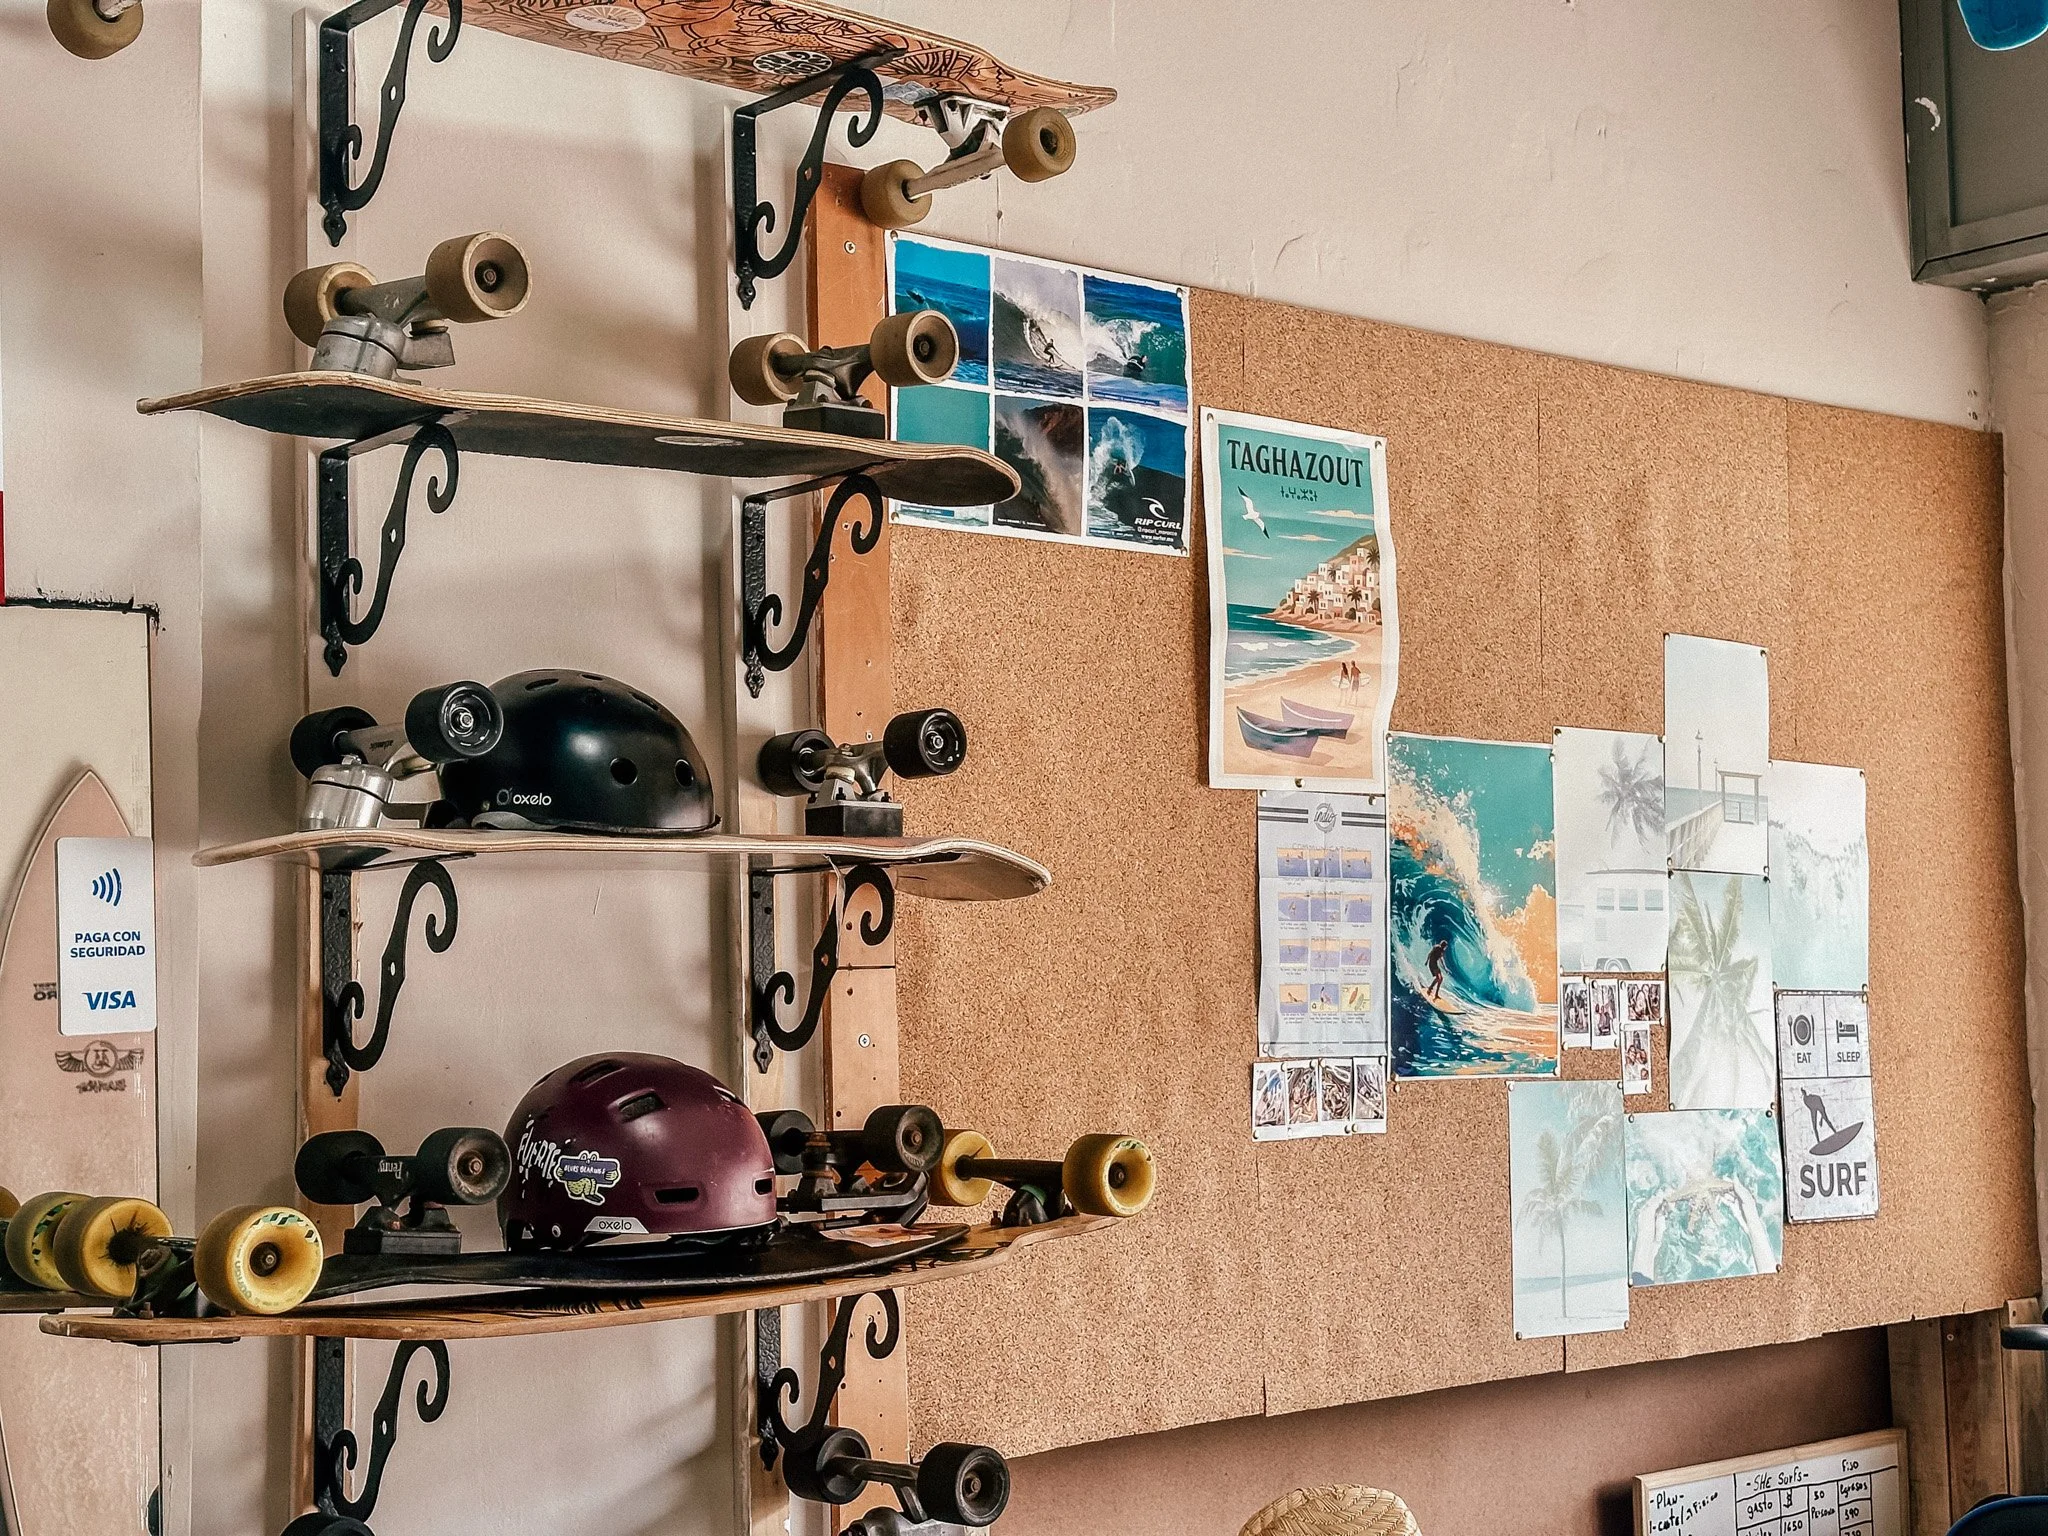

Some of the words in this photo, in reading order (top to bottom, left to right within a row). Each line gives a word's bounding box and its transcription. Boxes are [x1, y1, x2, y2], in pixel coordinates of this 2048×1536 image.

[1227, 439, 1363, 488] TAGHAZOUT
[1134, 517, 1153, 526] RIP
[1154, 520, 1182, 530] CURL
[512, 792, 552, 806] oxelo
[75, 932, 111, 943] PAGA
[113, 931, 141, 942] CON
[70, 945, 146, 958] SEGURIDAD
[82, 990, 137, 1010] VISA
[1796, 1052, 1812, 1064] EAT
[1837, 1051, 1861, 1062] SLEEP
[377, 1160, 403, 1179] Penny
[1800, 1162, 1867, 1199] SURF
[598, 1219, 633, 1231] oxelo
[1784, 1520, 1803, 1534] 1650
